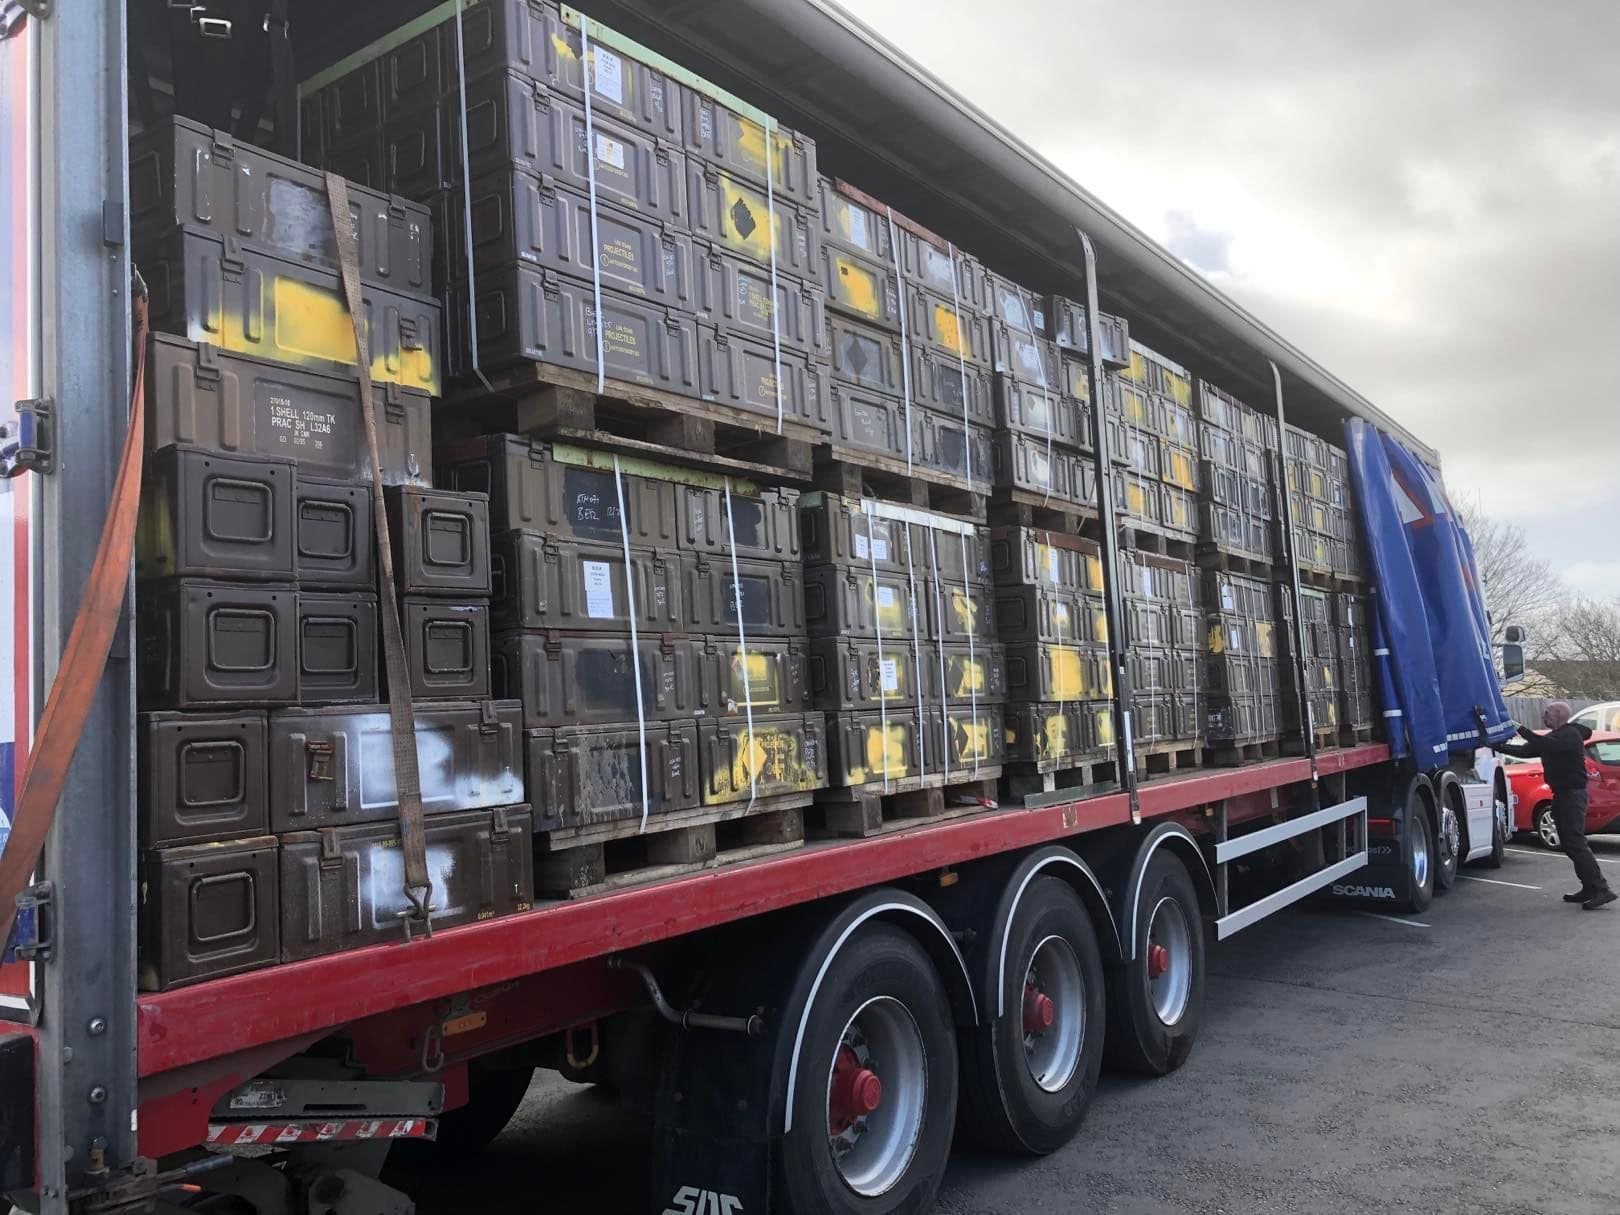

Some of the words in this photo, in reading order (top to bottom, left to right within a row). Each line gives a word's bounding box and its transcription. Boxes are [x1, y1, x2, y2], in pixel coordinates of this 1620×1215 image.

[276, 406, 299, 419] SHELL
[303, 410, 325, 422] 120mm
[326, 413, 336, 425] TK
[271, 416, 292, 428] PRAC
[295, 420, 305, 430] SH
[310, 422, 331, 434] L32A6
[1332, 885, 1396, 898] SCANIA
